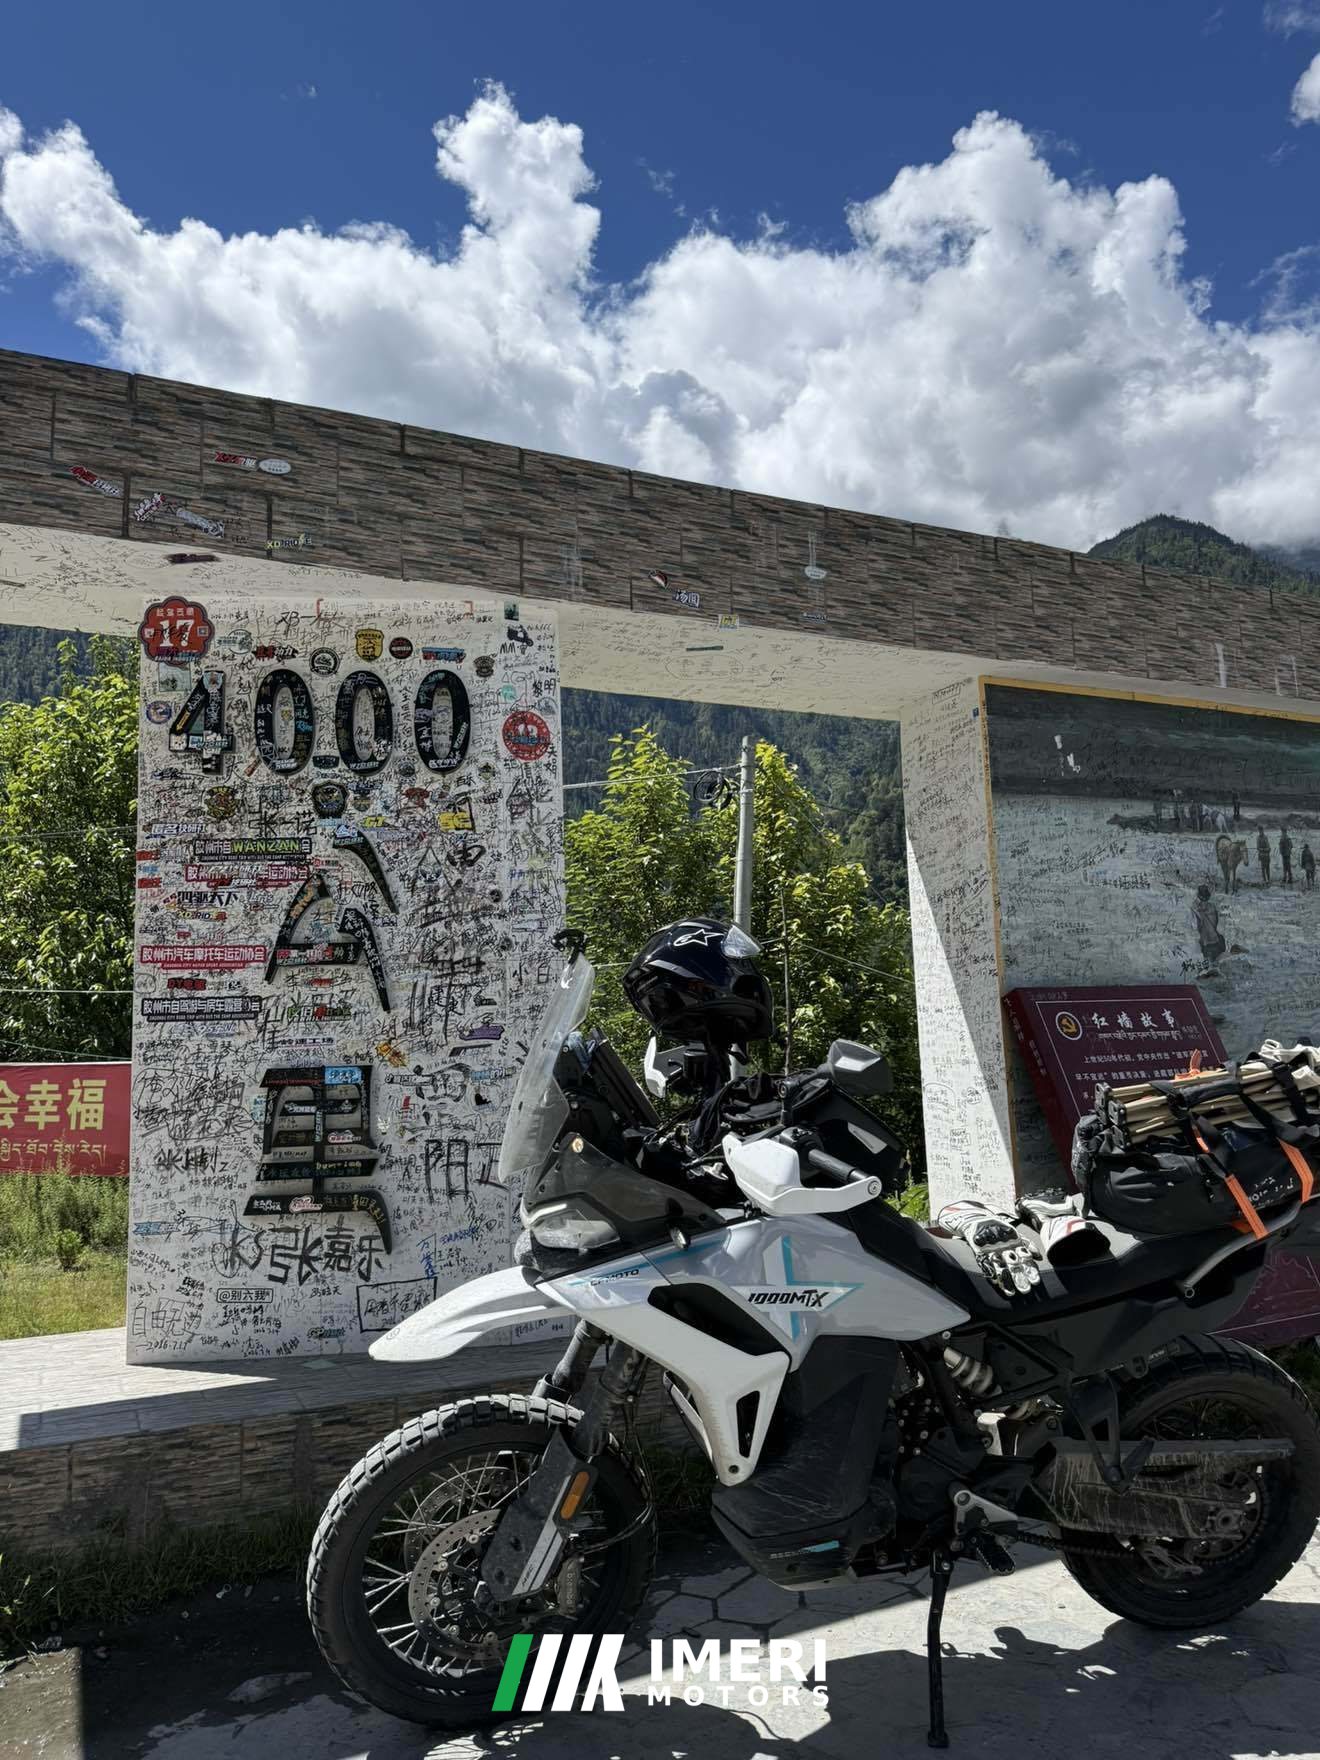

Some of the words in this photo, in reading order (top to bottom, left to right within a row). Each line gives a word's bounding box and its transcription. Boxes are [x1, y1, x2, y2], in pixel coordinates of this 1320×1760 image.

[159, 620, 195, 647] 17
[168, 669, 471, 775] 4000
[233, 839, 300, 853] WANZAN
[591, 1269, 640, 1286] CMOTO
